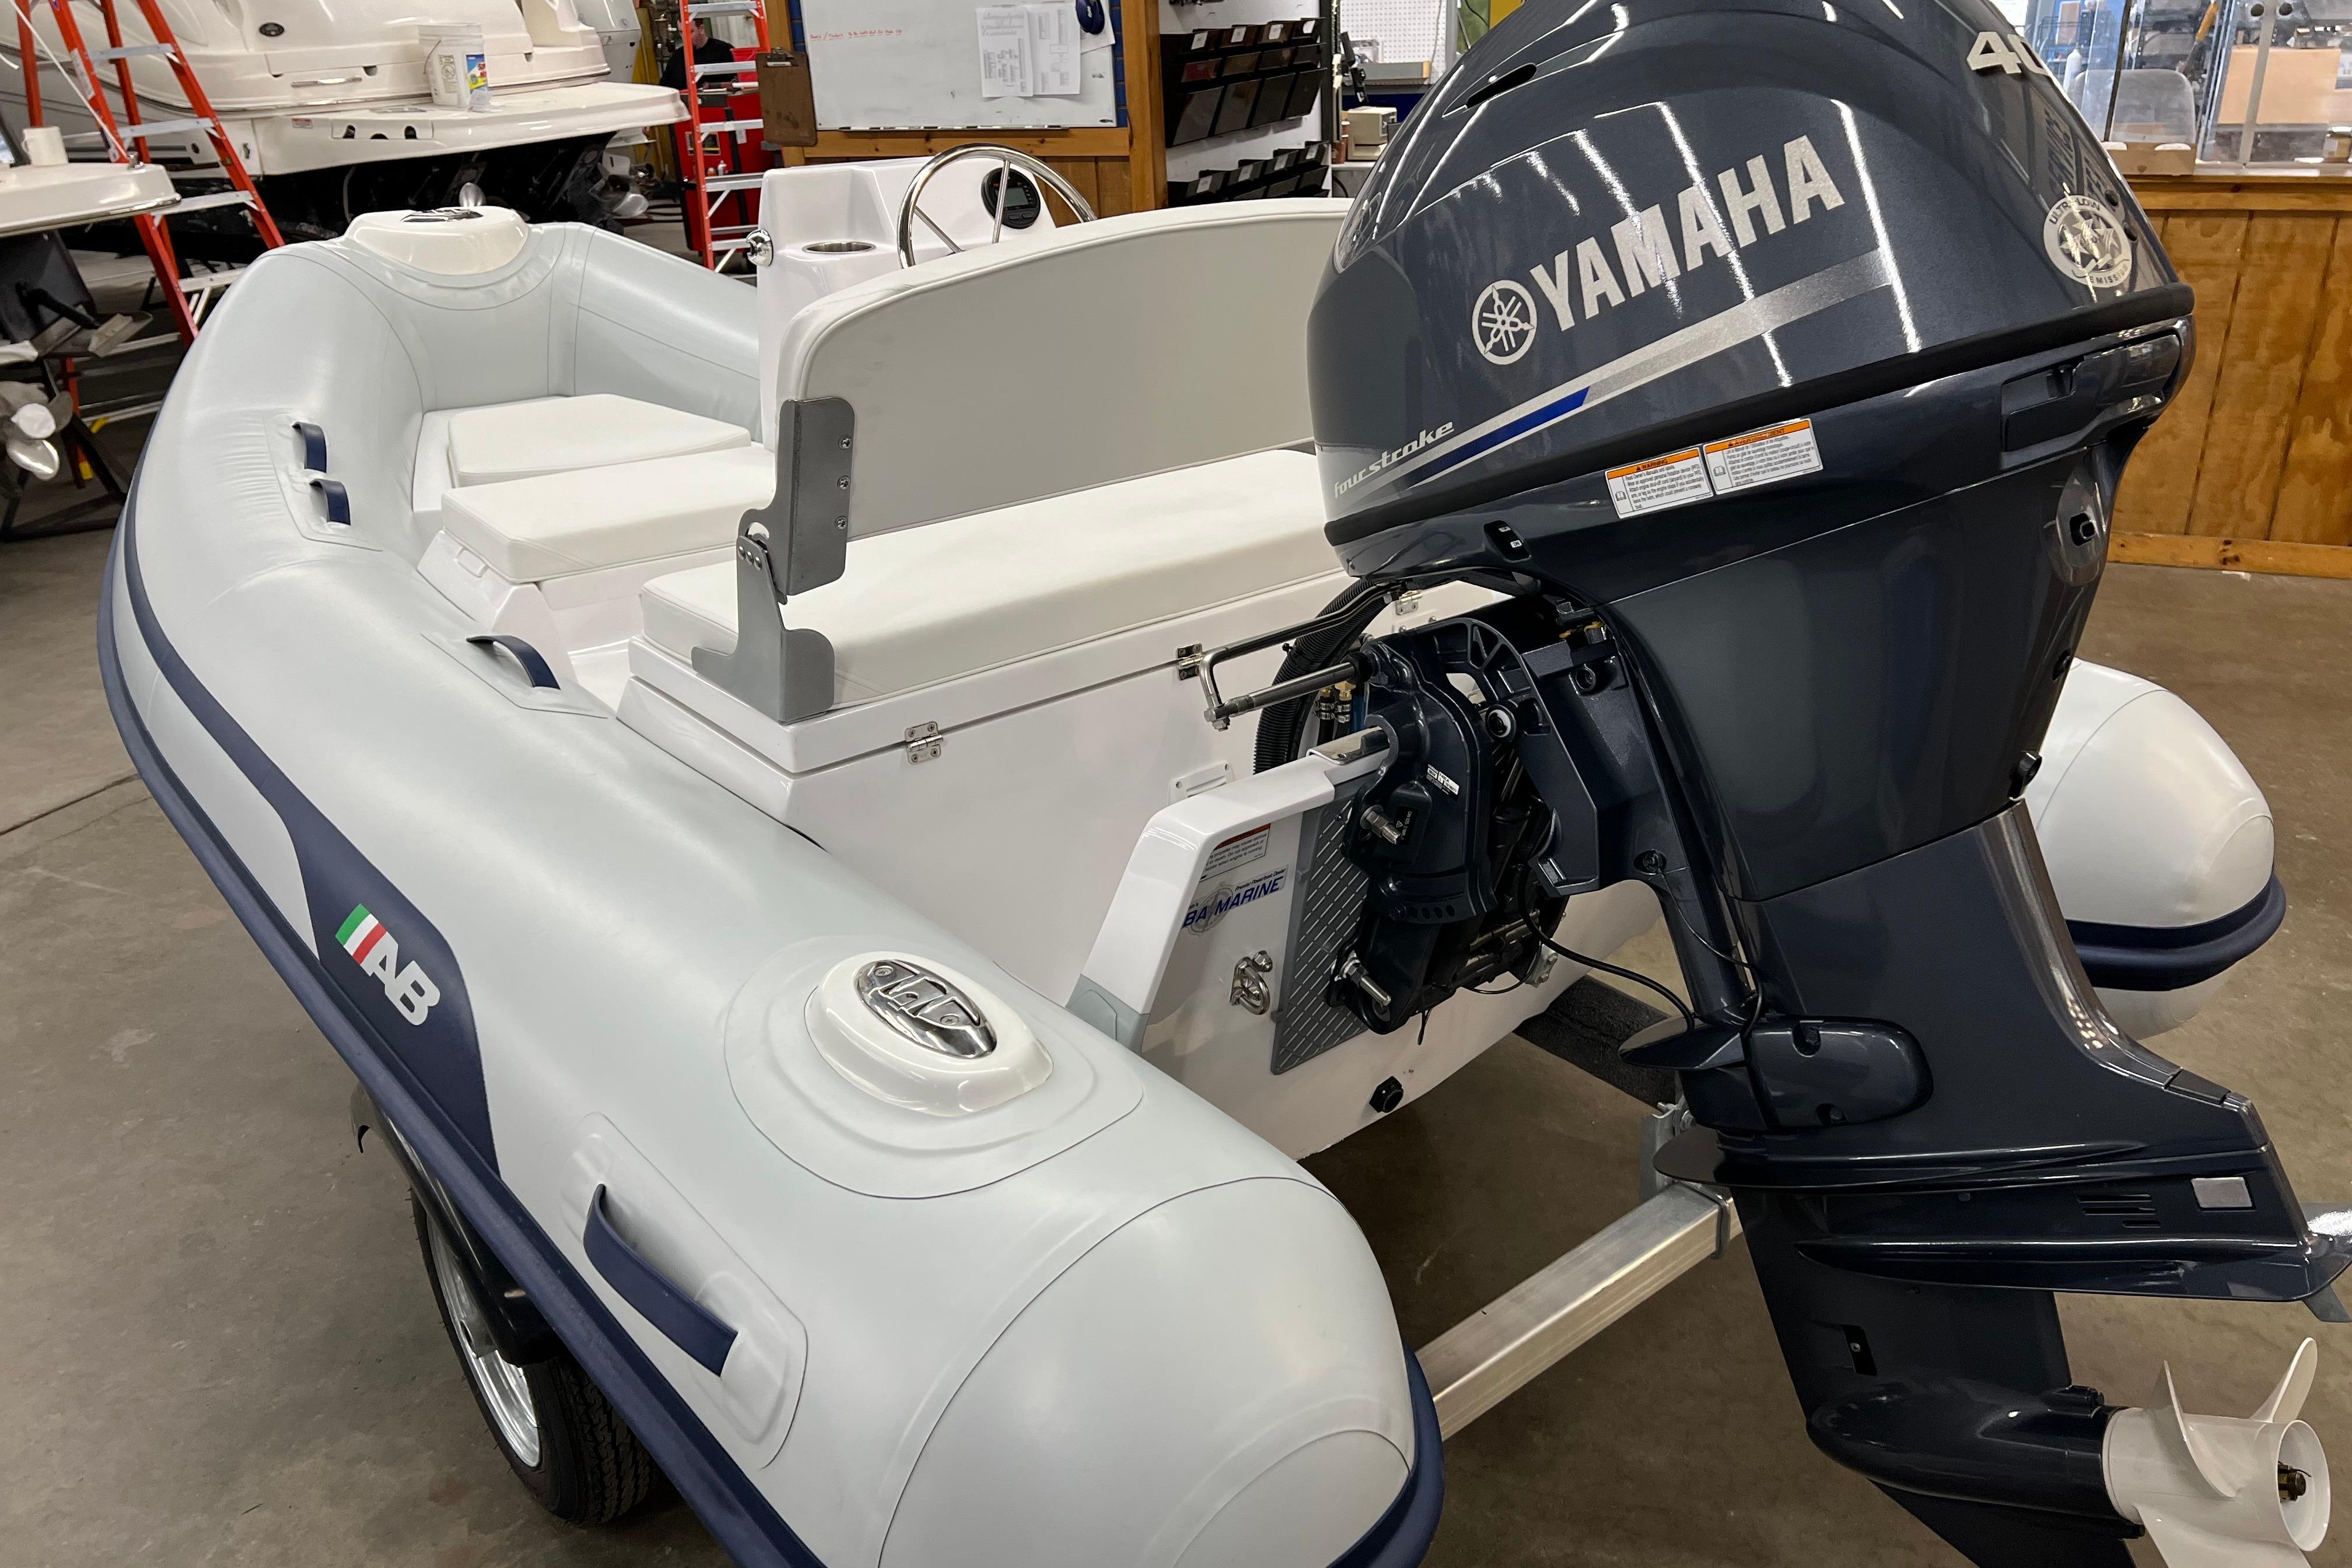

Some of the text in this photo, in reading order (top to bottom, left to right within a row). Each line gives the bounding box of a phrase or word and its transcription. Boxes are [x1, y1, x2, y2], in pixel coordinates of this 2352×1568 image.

[1530, 135, 1845, 331] YAMAHA
[1642, 459, 1668, 469] WARNING
[1214, 876, 1284, 915] MARINE
[1235, 869, 1286, 891] Premier Powerboat Dealer
[359, 932, 440, 1026] AB
